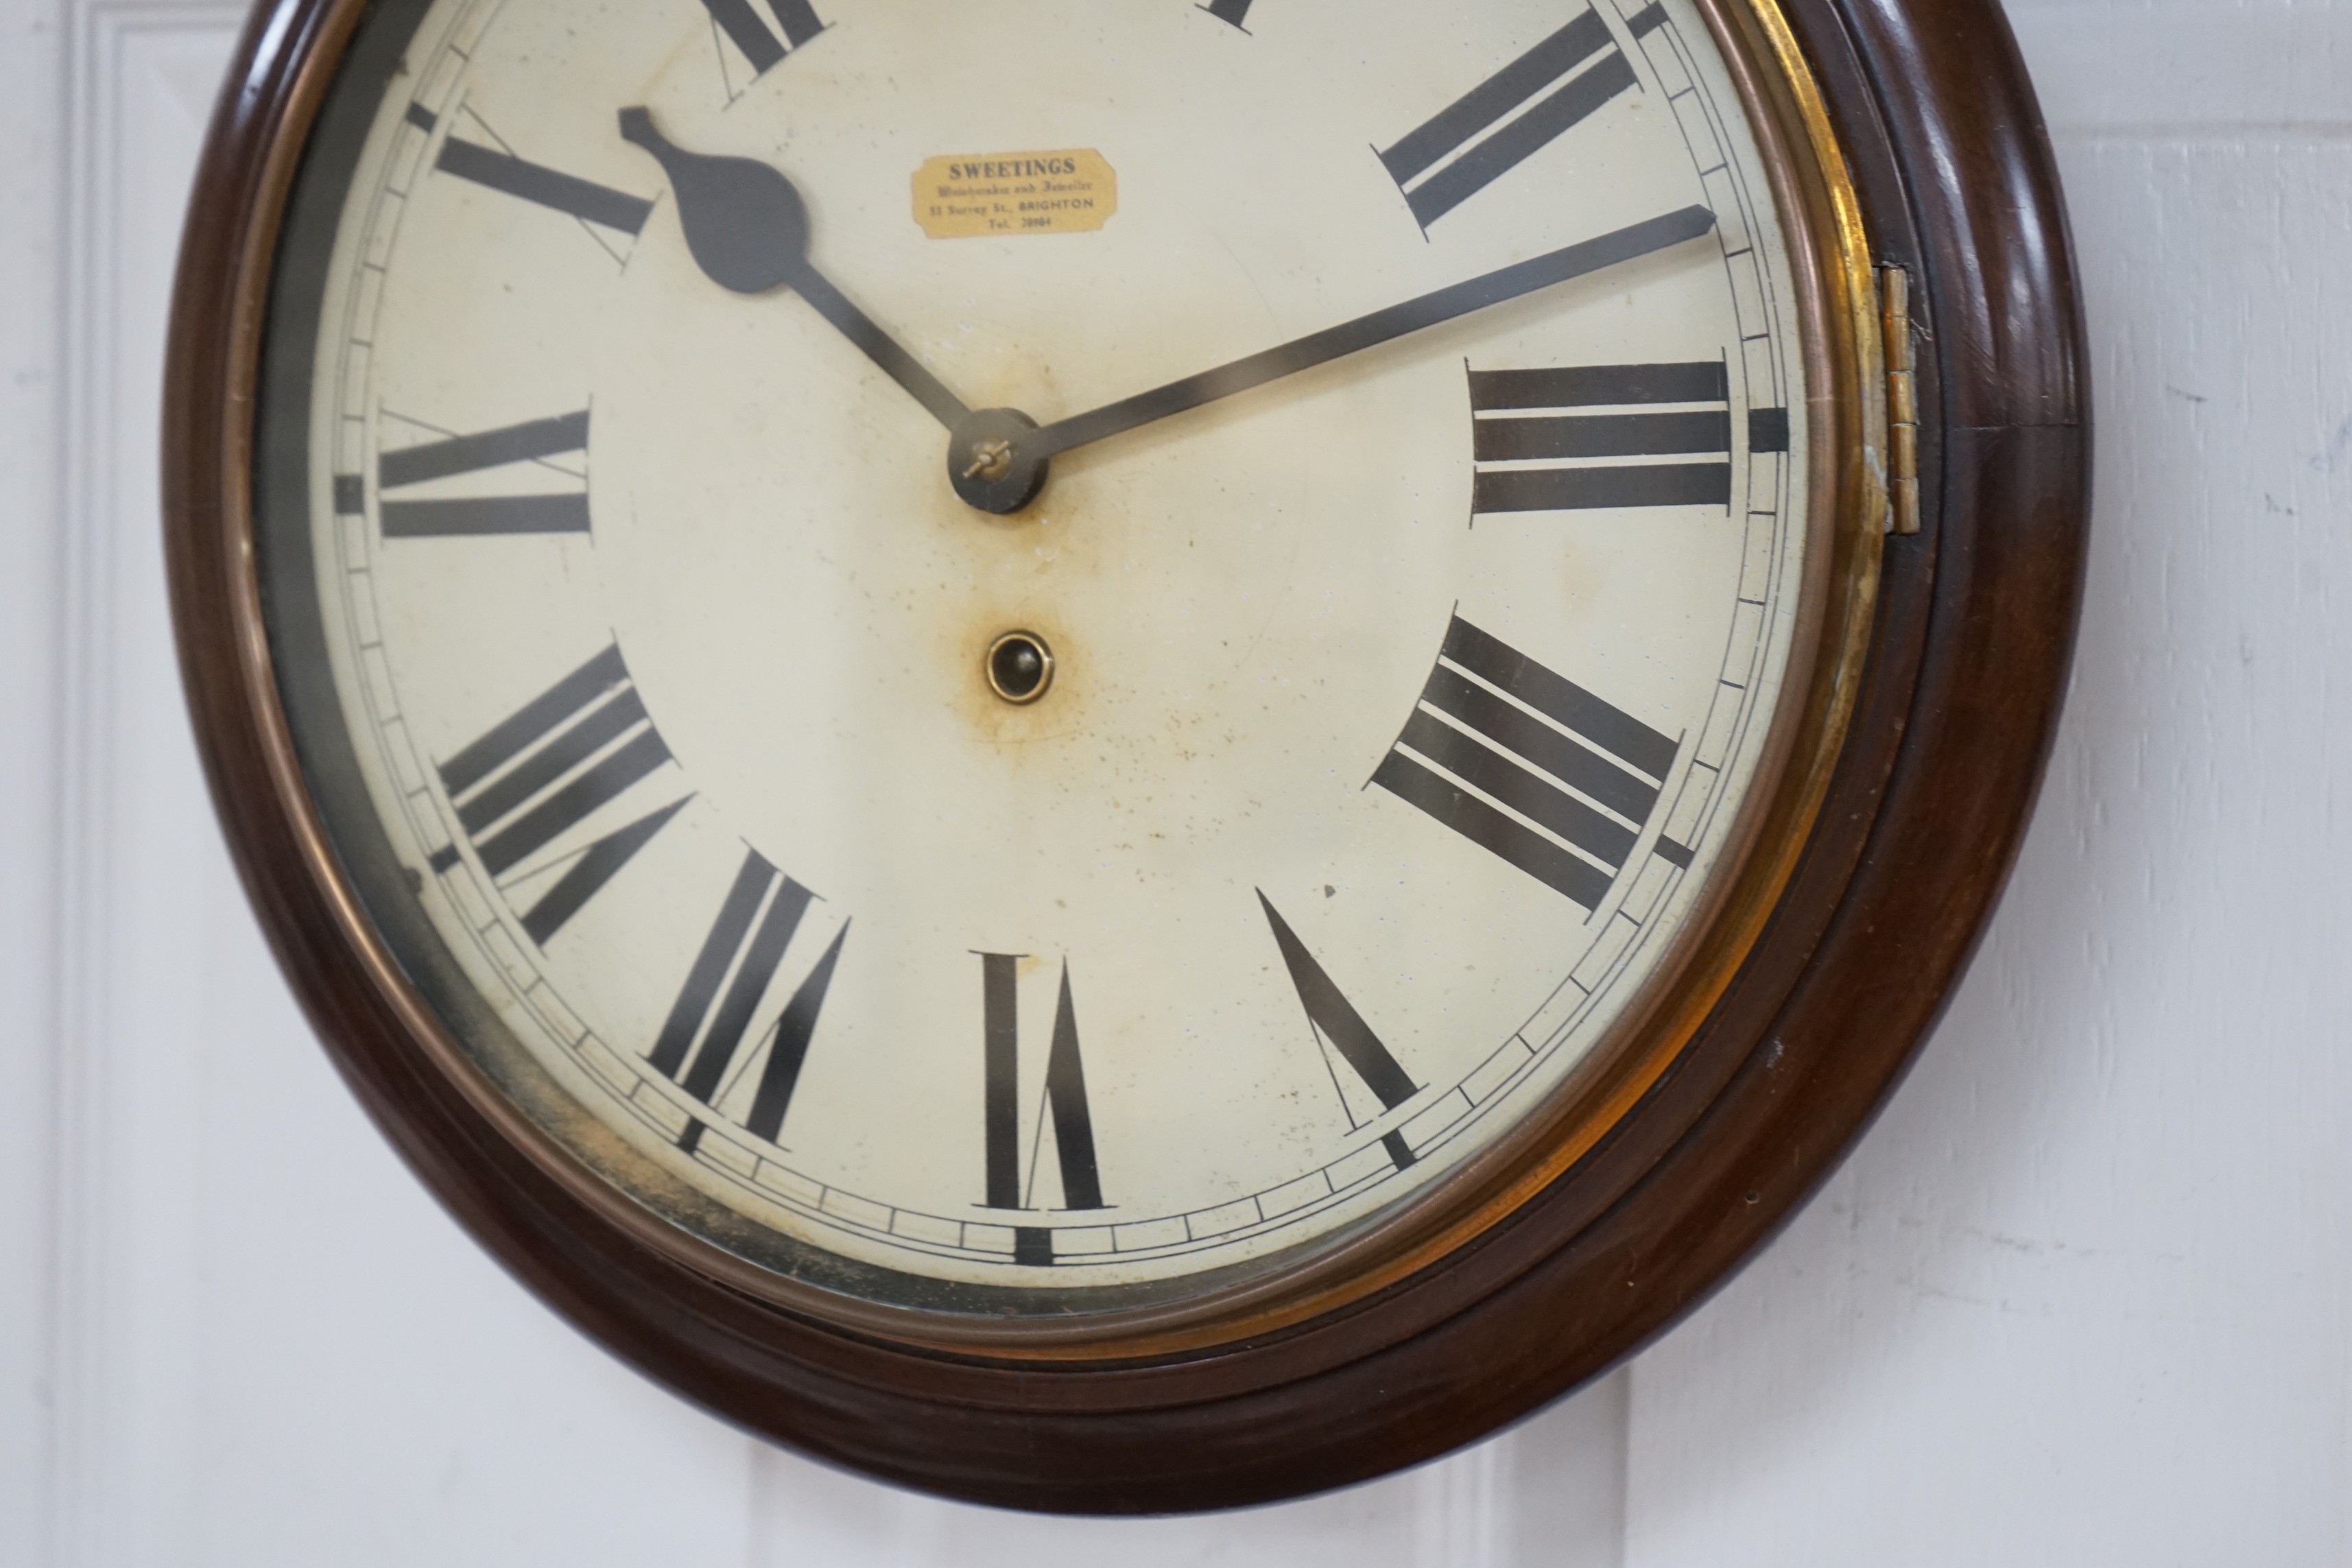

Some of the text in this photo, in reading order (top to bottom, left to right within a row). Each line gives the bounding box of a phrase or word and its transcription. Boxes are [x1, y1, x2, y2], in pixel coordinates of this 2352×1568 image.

[949, 157, 1076, 180] SWEETINGS
[1019, 198, 1094, 212] BRIGHTON
[1464, 346, 1733, 530] III
[1361, 599, 1686, 926] IIII
[1255, 886, 1430, 1137] V
